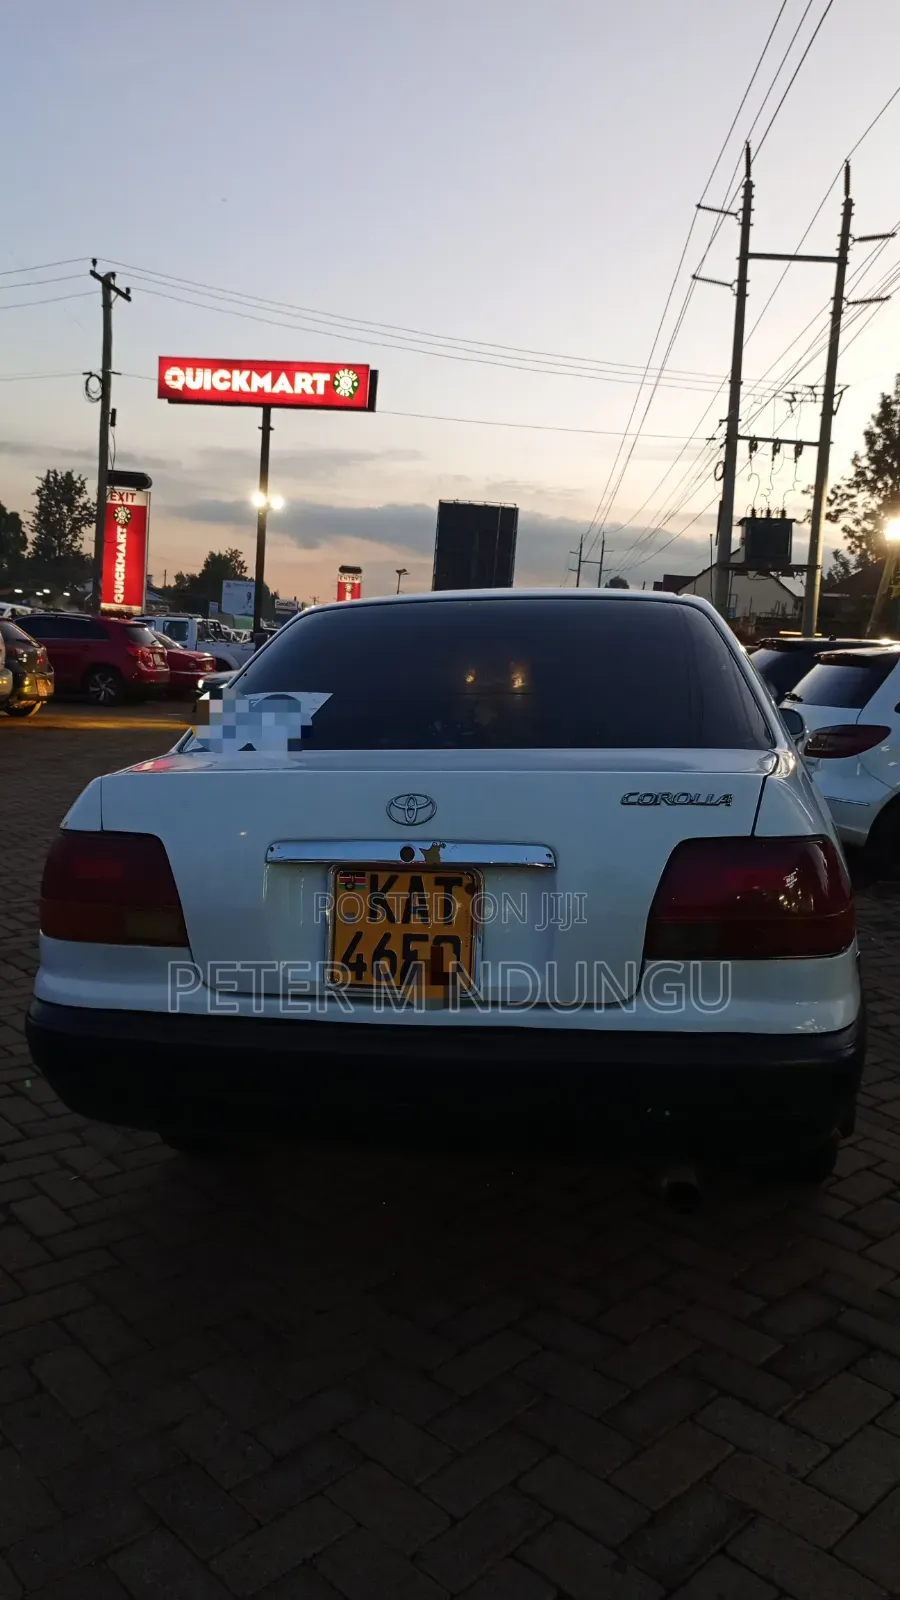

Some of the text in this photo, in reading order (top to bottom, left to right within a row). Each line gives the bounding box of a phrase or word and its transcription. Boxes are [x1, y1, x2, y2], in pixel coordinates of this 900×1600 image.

[164, 366, 331, 395] QUICKMART
[335, 368, 358, 381] FRESH
[110, 491, 137, 503] EXIT
[113, 525, 127, 604] QUICKMART
[620, 792, 733, 806] COROLLA
[369, 874, 463, 925] KAT
